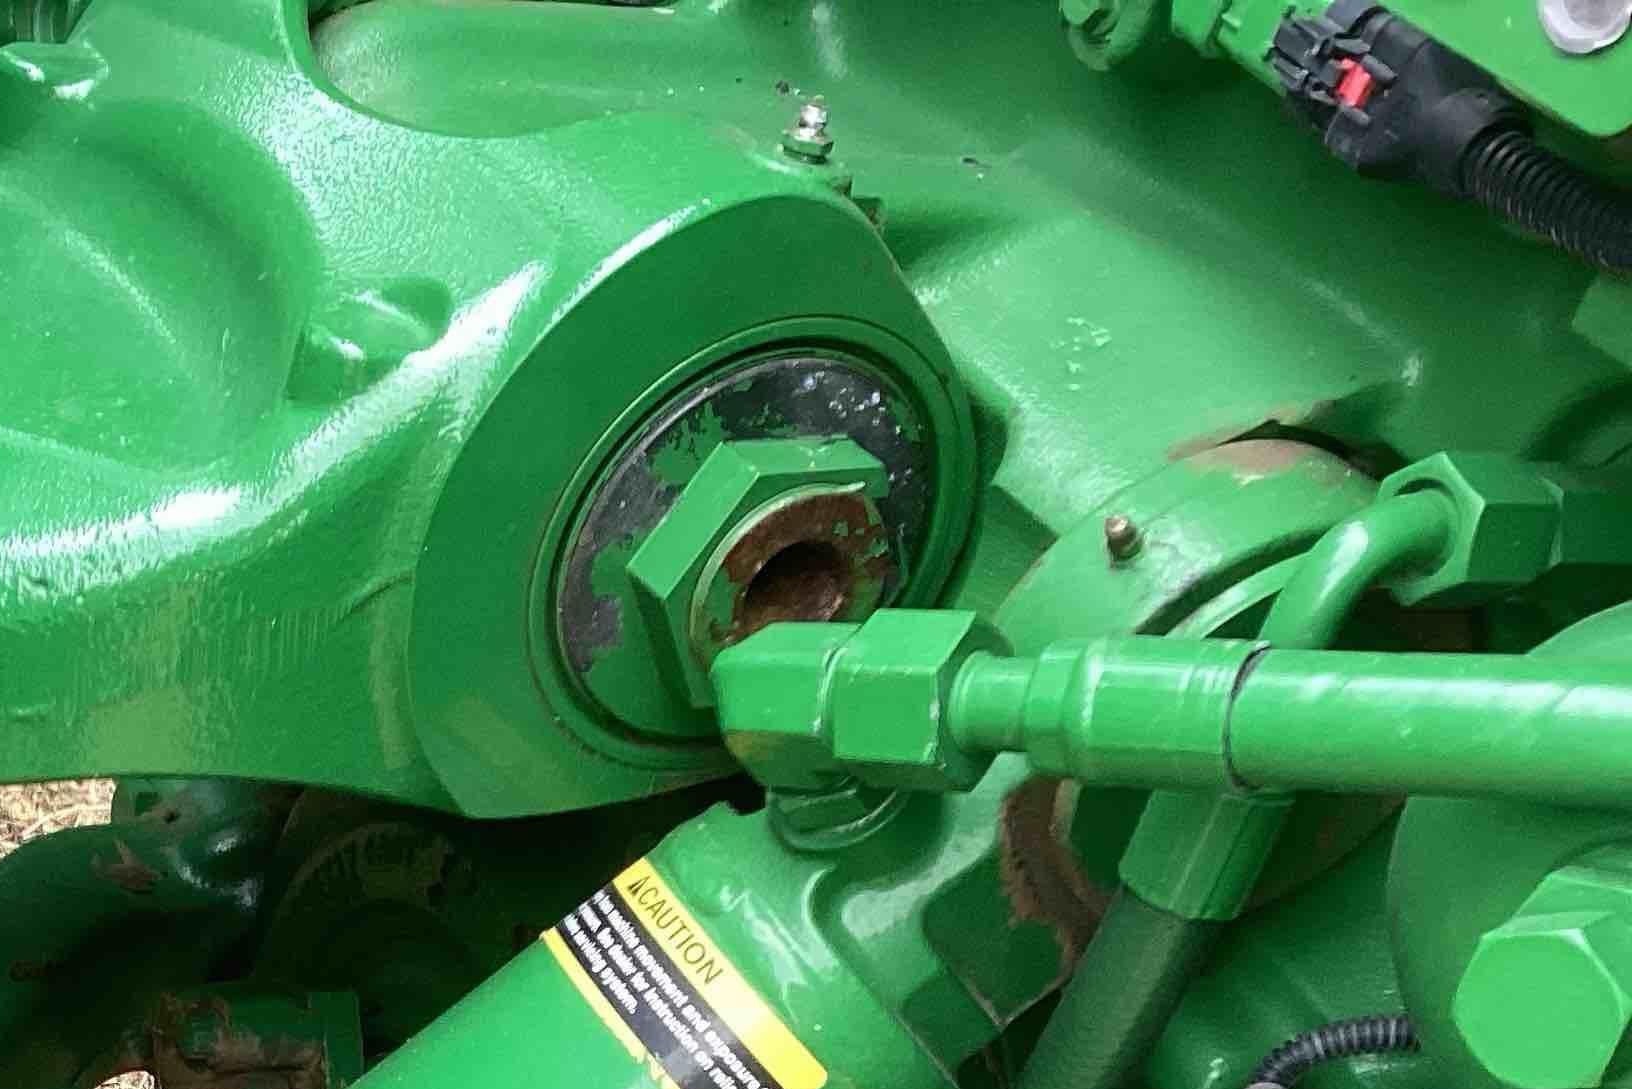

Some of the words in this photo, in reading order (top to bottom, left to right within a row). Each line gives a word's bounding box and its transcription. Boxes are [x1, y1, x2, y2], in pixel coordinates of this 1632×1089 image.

[638, 887, 722, 983] CAUTION
[633, 944, 688, 1007] movement
[681, 1004, 711, 1034] and
[643, 986, 703, 1054] instruction
[693, 1046, 714, 1070] on
